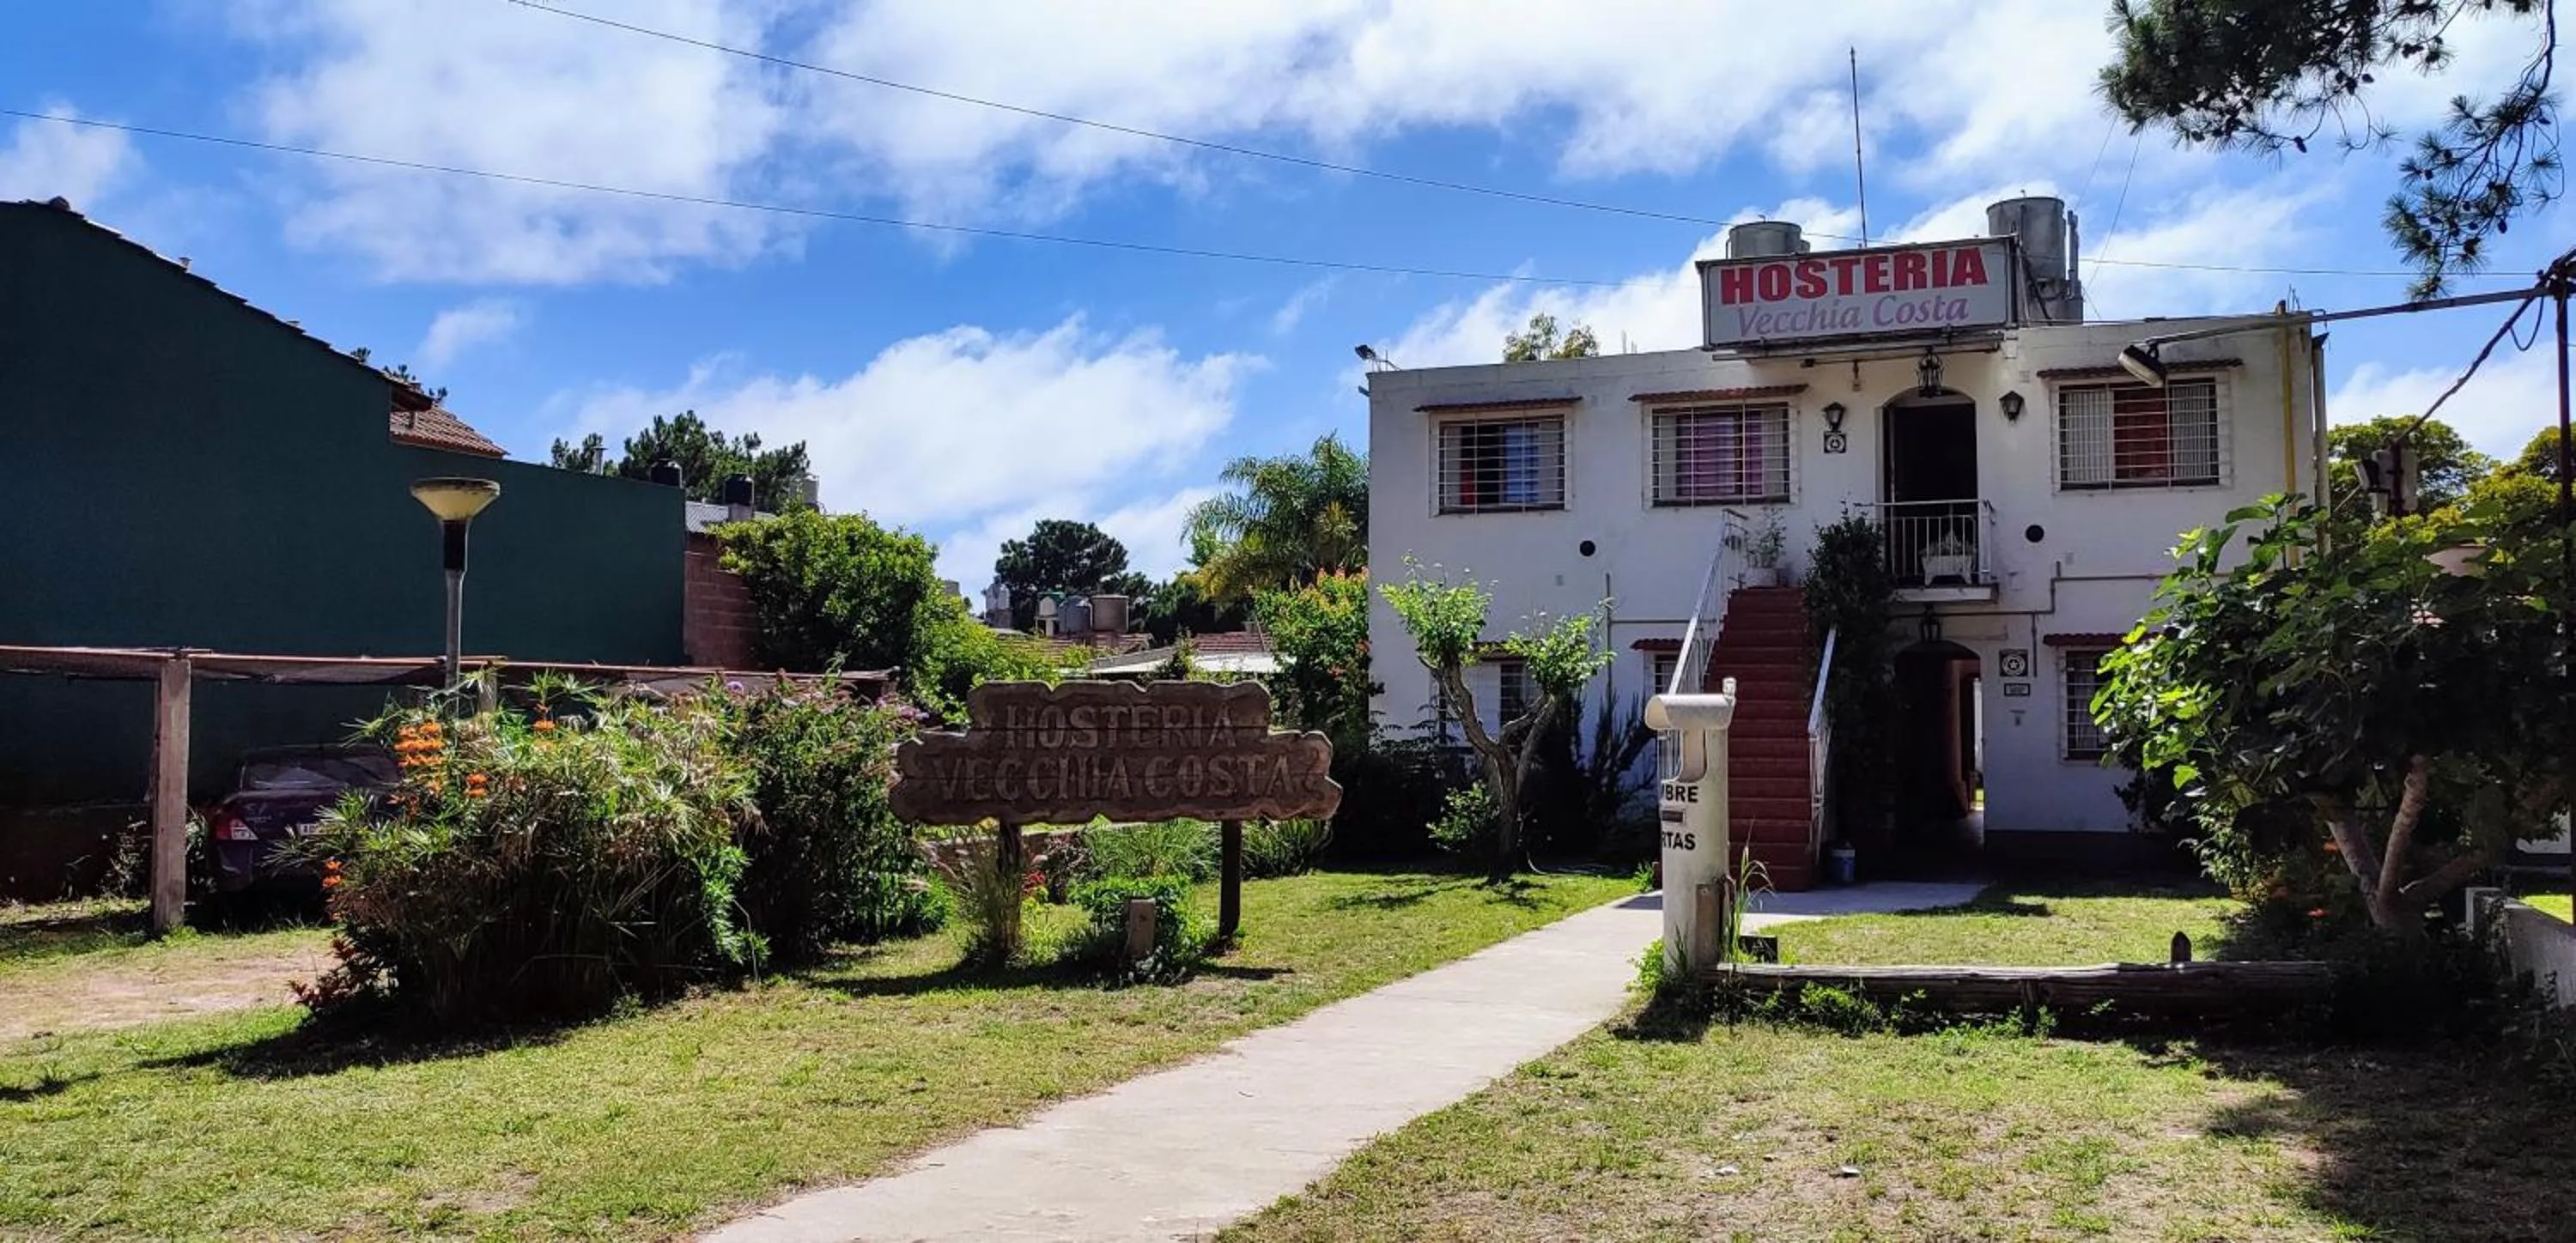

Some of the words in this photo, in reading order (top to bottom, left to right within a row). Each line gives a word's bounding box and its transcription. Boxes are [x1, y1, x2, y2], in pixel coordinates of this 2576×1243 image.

[1721, 246, 1988, 305] HOSTERIA
[1739, 298, 1861, 337] Vecchia
[1873, 294, 1969, 326] Costa
[1005, 704, 1236, 749] HOSTERIA
[933, 755, 1132, 801] VECCHIA
[1145, 755, 1296, 799] COSTA
